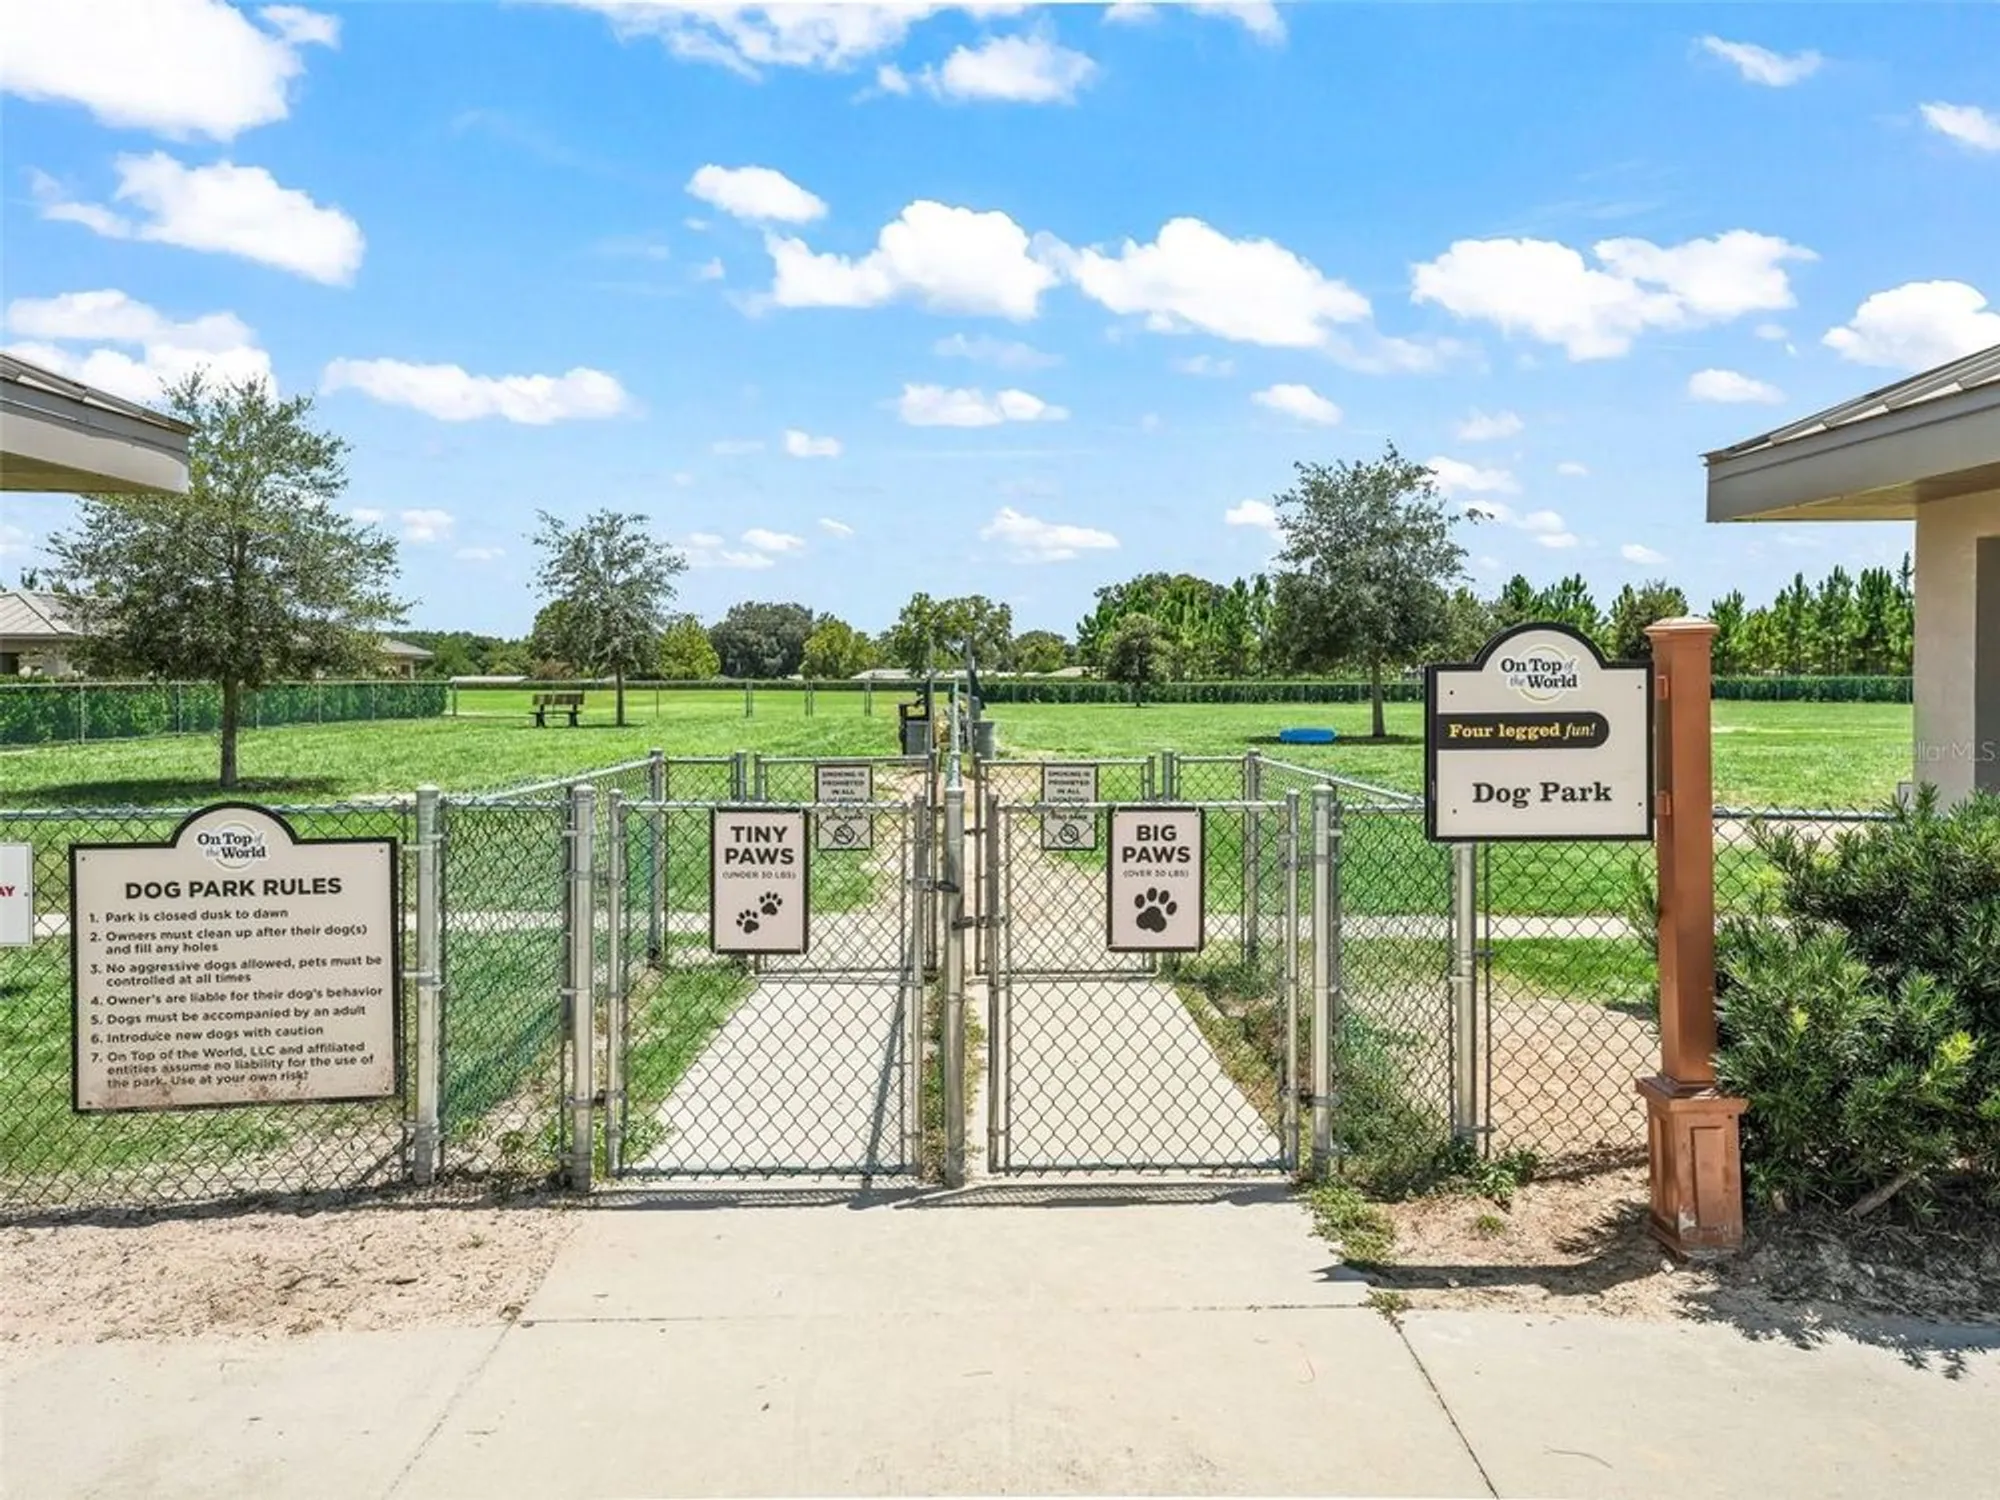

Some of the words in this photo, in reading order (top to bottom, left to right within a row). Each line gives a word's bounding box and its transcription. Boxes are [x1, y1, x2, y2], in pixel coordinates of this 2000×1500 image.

[1501, 658, 1526, 673] On
[1529, 658, 1562, 675] Top
[1564, 658, 1575, 675] of
[1510, 675, 1525, 687] the
[1527, 674, 1577, 689] World
[1450, 724, 1493, 738] Four
[1498, 723, 1560, 741] legged
[1563, 722, 1596, 740] fun!
[1472, 782, 1531, 809] Dog
[1539, 781, 1613, 803] Park
[197, 832, 220, 845] On
[222, 832, 252, 847] Top
[254, 832, 264, 846] of
[730, 826, 788, 843] TINY
[1136, 825, 1177, 841] BIG
[221, 846, 266, 859] World
[725, 848, 795, 865] PAWS
[1122, 846, 1191, 863] PAWS
[722, 870, 759, 880] (UNDER
[1123, 869, 1152, 878] (OVER
[125, 881, 181, 899] DOG
[188, 879, 256, 898] PARK
[263, 877, 342, 896] RULES
[89, 913, 100, 923] 1.
[106, 911, 135, 923] Park
[139, 911, 150, 922] is
[154, 909, 197, 922] closed
[201, 909, 232, 920] dusk
[236, 909, 249, 919] to
[253, 907, 289, 919] dawn
[90, 932, 101, 942] 2.
[106, 931, 157, 942] Owners
[160, 930, 192, 940] must
[197, 928, 232, 939] clean
[236, 931, 253, 940] up
[256, 926, 287, 938] after
[291, 925, 321, 936] their
[324, 924, 368, 937] dog(s)
[106, 943, 132, 955] and
[135, 943, 152, 954] fill
[156, 945, 180, 955] any
[183, 943, 219, 953] holes
[90, 964, 101, 975] 3.
[106, 964, 126, 974] No
[130, 961, 200, 974] aggressive
[204, 960, 237, 972] dogs
[240, 958, 296, 969] allowed,
[299, 957, 328, 969] pets
[331, 956, 362, 966] must
[366, 955, 382, 965] be
[106, 975, 175, 987] controlled
[179, 975, 191, 985] at
[196, 974, 212, 984] all
[216, 973, 251, 983] times
[90, 996, 103, 1006] 4.
[106, 994, 162, 1006] Owner's
[165, 995, 187, 1004] are
[190, 992, 227, 1003] liable
[230, 991, 249, 1001] for
[253, 990, 283, 1000] their
[287, 988, 323, 1001] dog's
[326, 987, 383, 997] behavior
[90, 1014, 103, 1025] 5.
[107, 1014, 141, 1026] Dogs
[145, 1012, 178, 1023] must
[182, 1011, 199, 1021] be
[202, 1007, 290, 1021] accompanied
[294, 1007, 310, 1018] by
[314, 1008, 330, 1016] an
[332, 1006, 366, 1016] adult
[106, 1031, 172, 1044] Introduce
[176, 1032, 202, 1040] new
[206, 1028, 239, 1040] dogs
[243, 1026, 272, 1037] with
[275, 1025, 324, 1037] caution
[107, 1051, 127, 1062] On
[131, 1051, 156, 1062] Top
[159, 1050, 175, 1060] of
[177, 1048, 199, 1059] the
[203, 1047, 248, 1058] World,
[251, 1046, 276, 1056] LLC
[279, 1045, 304, 1055] and
[307, 1042, 366, 1053] affiliated
[106, 1063, 157, 1075] entities
[161, 1063, 210, 1073] assume
[214, 1062, 231, 1071] no
[234, 1058, 284, 1070] liability
[287, 1057, 307, 1068] for
[310, 1056, 332, 1067] the
[334, 1057, 357, 1066] use
[360, 1054, 374, 1065] of
[107, 1078, 129, 1089] the
[133, 1077, 168, 1089] park.
[171, 1076, 196, 1086] Use
[200, 1075, 213, 1085] at
[216, 1074, 246, 1086] your
[249, 1074, 278, 1083] own
